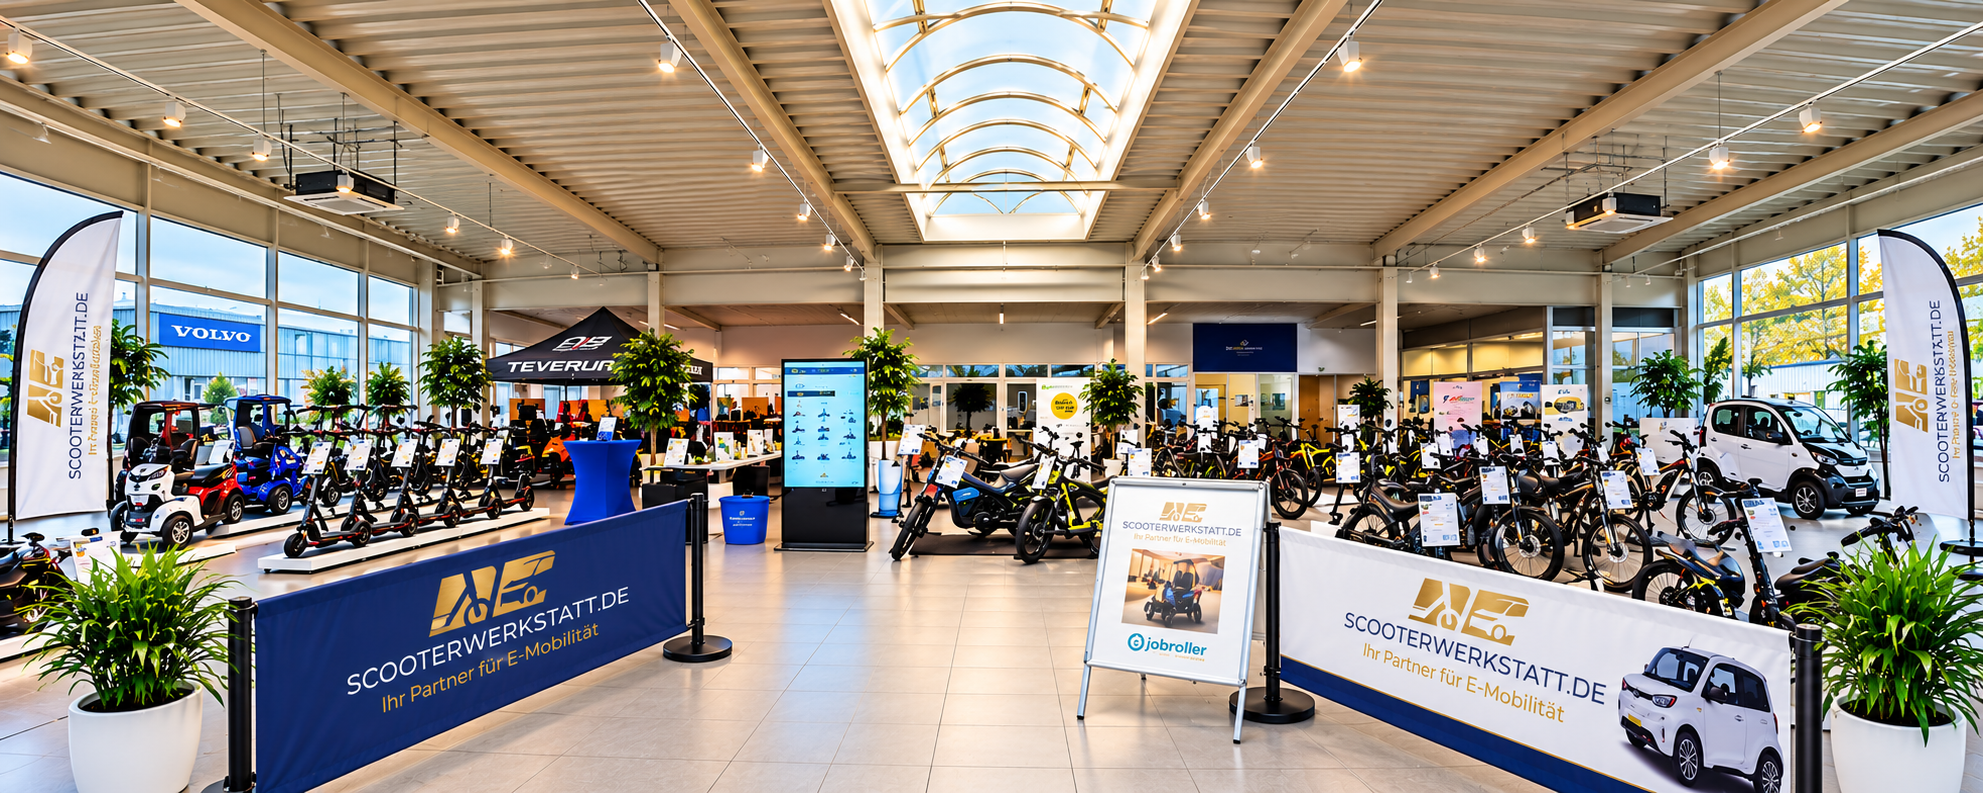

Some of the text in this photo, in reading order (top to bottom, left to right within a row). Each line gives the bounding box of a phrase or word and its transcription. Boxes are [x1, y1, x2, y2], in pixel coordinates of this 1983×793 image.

[171, 324, 252, 343] VOLVO
[1122, 521, 1242, 537] SCOOTERWERKSTATT.DE
[347, 586, 630, 695] SCOOTERWERKSTATT.DE
[382, 622, 599, 713] Ihr Partner für E-Mobilität
[1144, 637, 1208, 656] jobroller
[1344, 612, 1607, 705] SCOOTERWERKSTATT.DE
[1362, 642, 1565, 724] Ihr Partner für E-Mobilität
